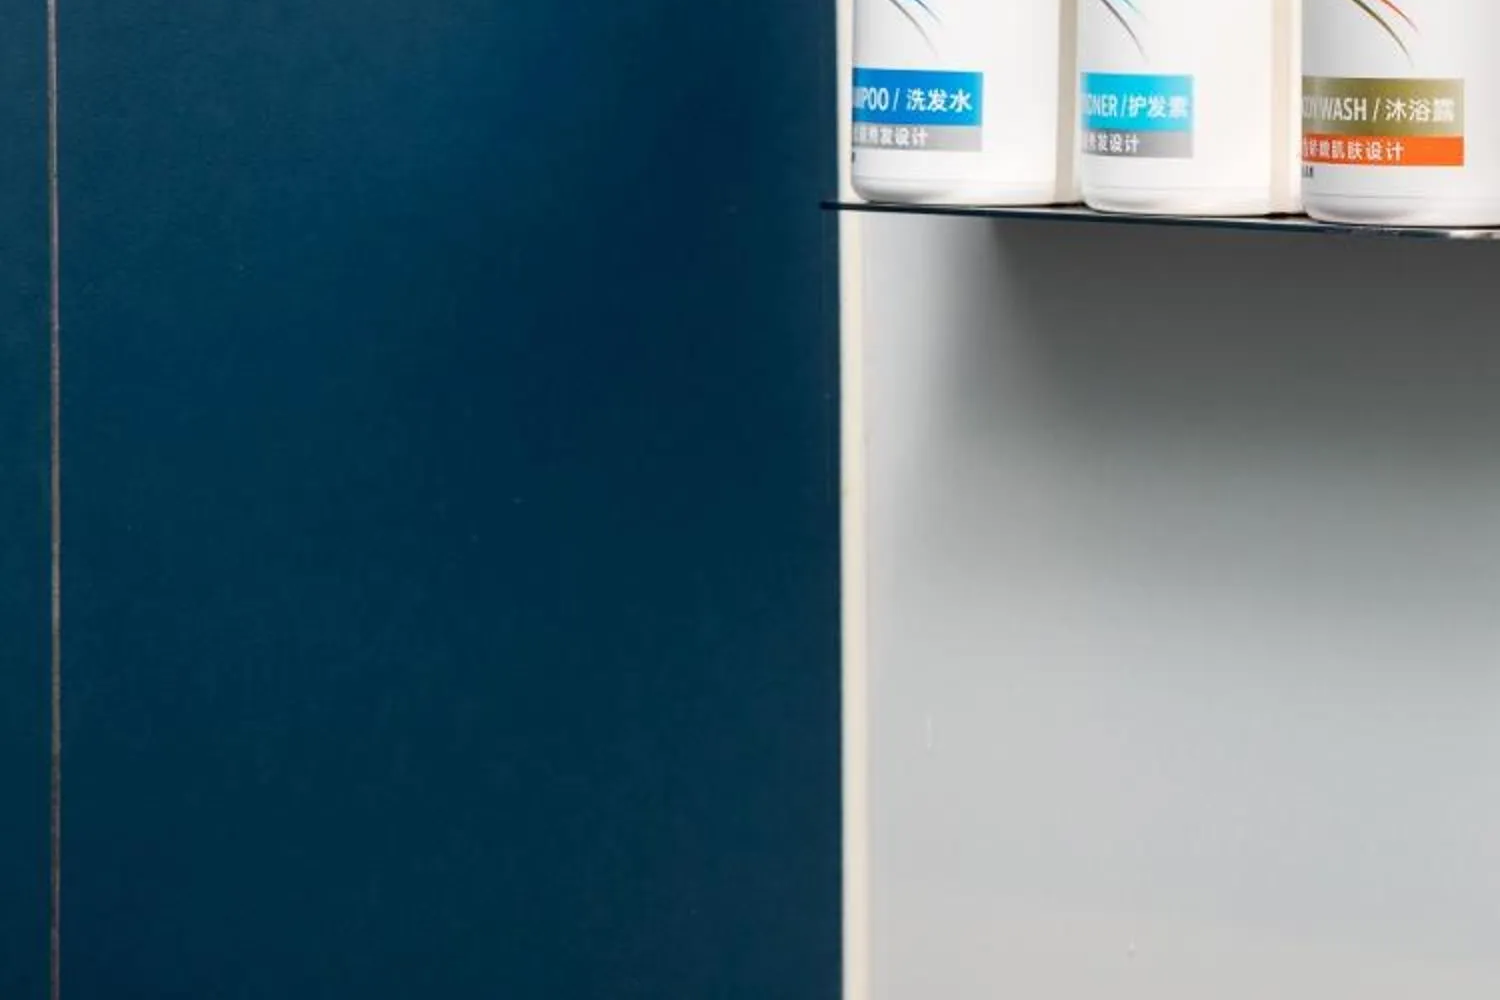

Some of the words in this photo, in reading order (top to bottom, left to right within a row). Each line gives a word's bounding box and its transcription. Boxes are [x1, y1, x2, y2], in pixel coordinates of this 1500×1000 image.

[853, 87, 889, 112] POO
[906, 87, 974, 113] 洗发水
[1321, 97, 1367, 121] WASH
[1385, 97, 1456, 122] 沐浴露
